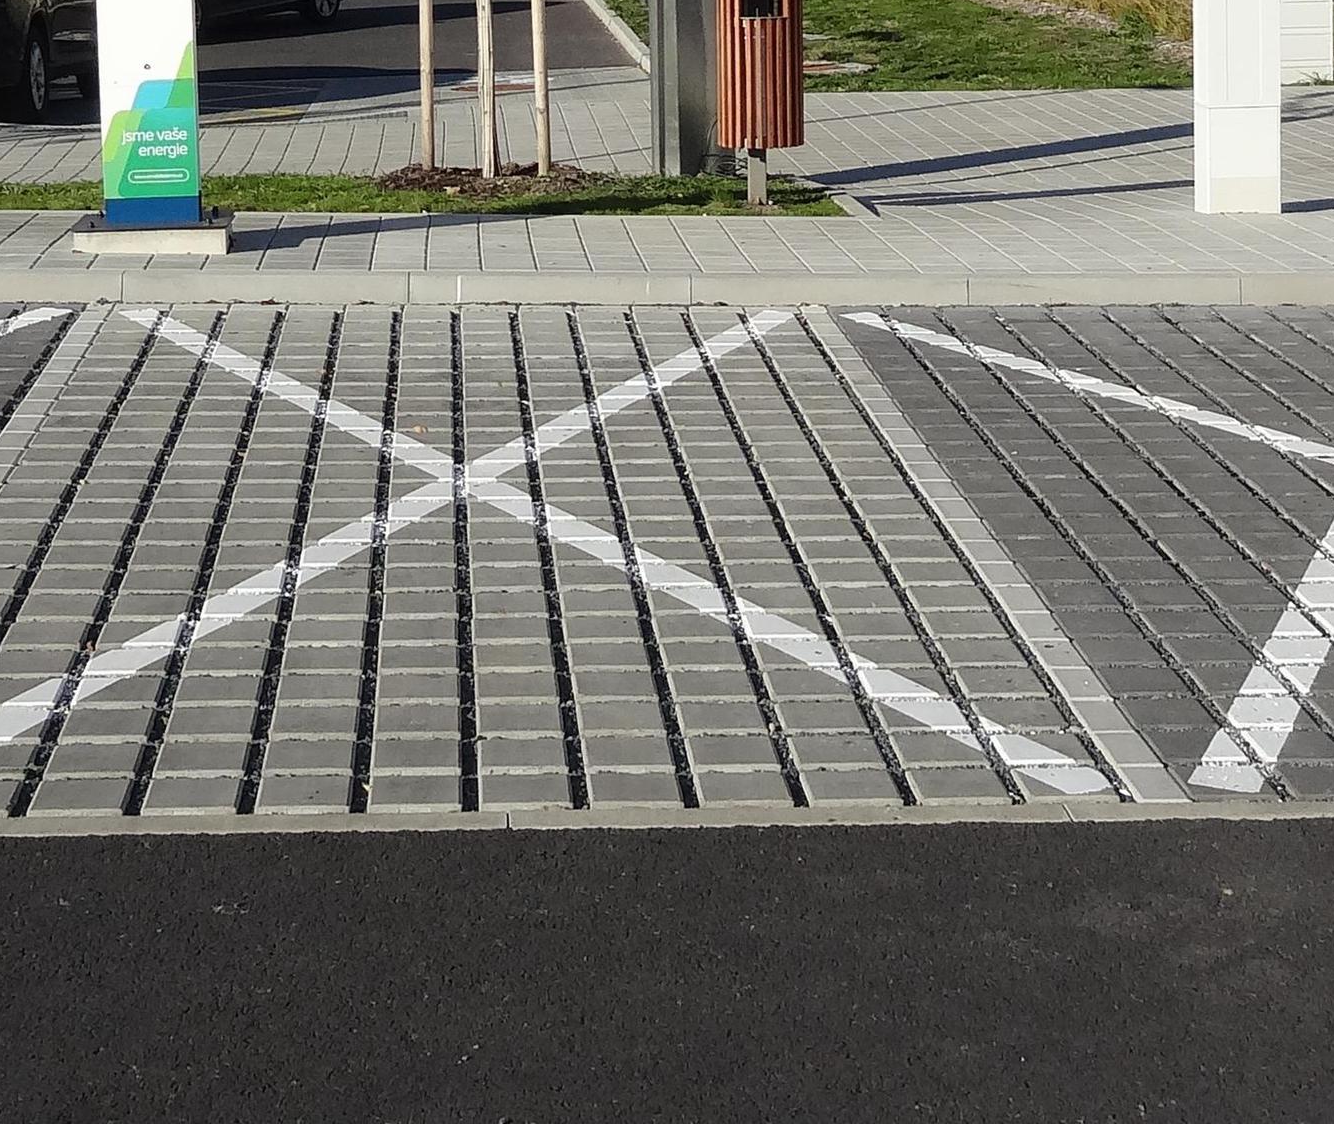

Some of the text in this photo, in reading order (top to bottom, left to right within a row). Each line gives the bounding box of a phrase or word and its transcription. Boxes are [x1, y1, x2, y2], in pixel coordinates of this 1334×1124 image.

[122, 126, 187, 146] jsme vaše
[138, 143, 188, 159] energie
